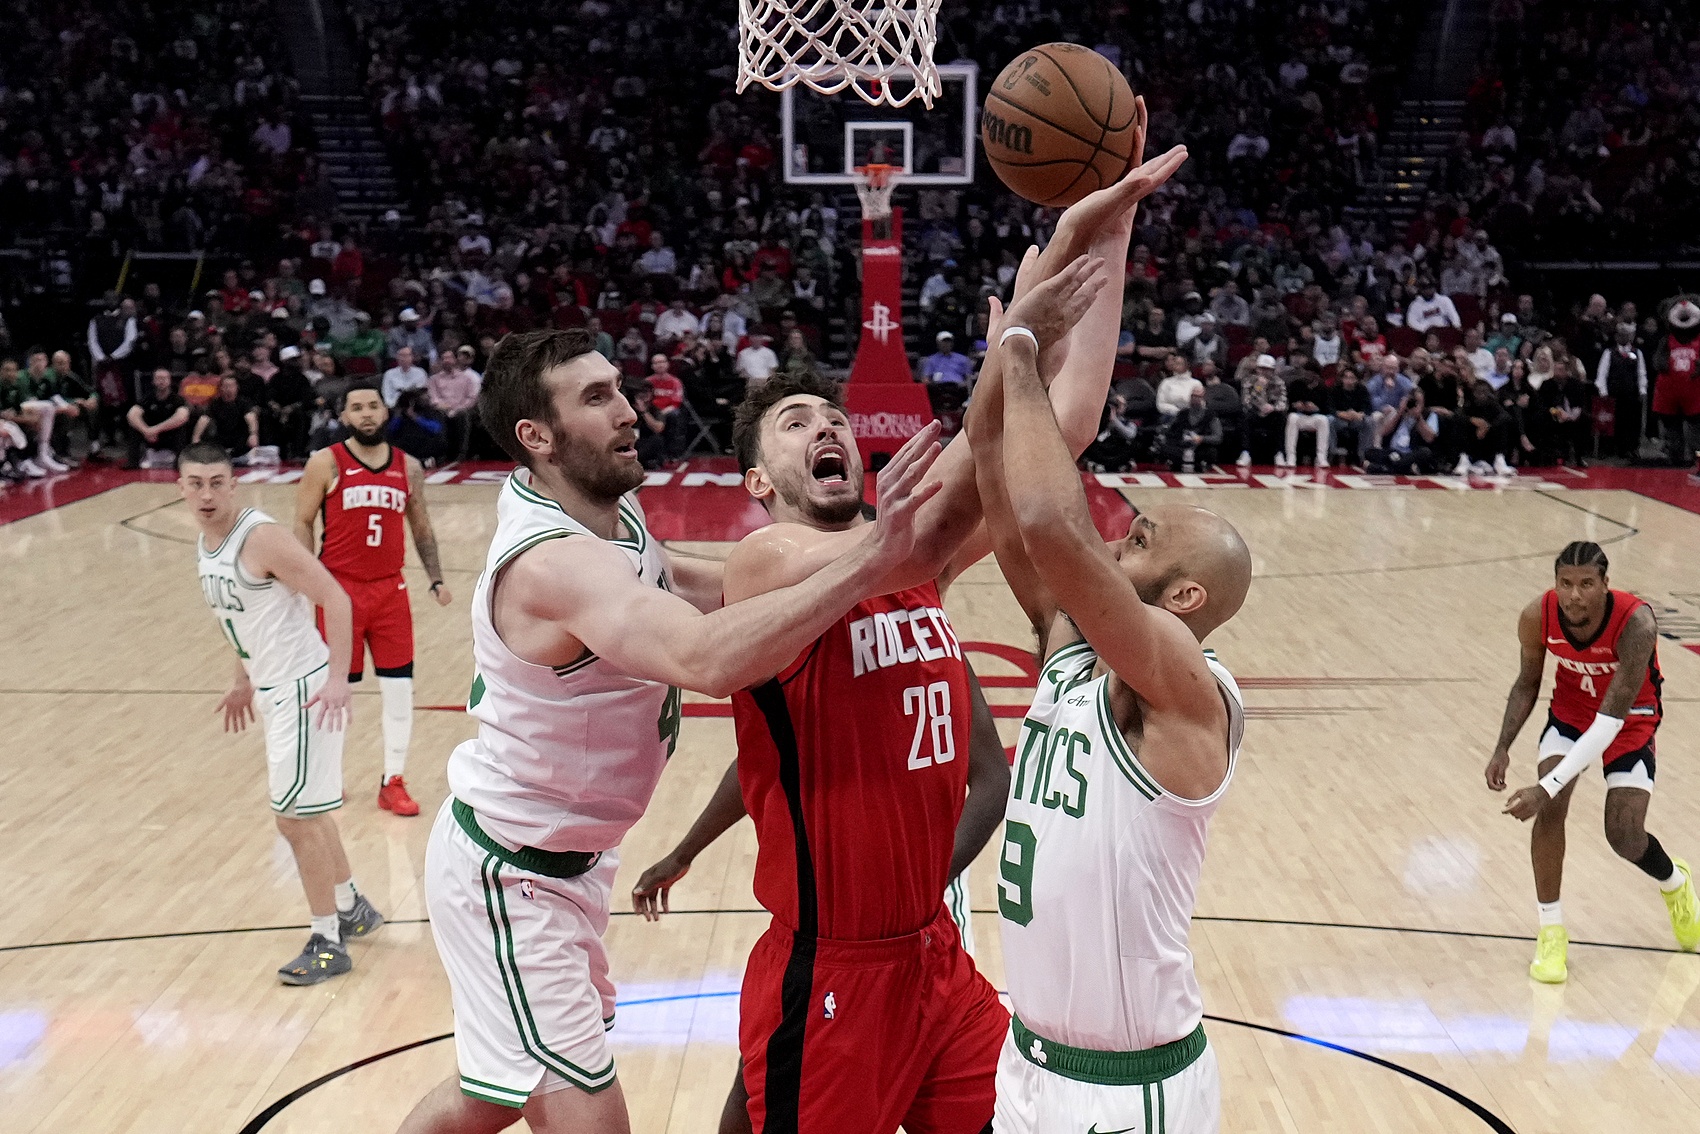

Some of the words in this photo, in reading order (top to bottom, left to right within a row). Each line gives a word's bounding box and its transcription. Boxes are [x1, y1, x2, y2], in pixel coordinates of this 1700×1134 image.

[342, 484, 407, 514] ROCKETS
[366, 513, 383, 547] 5
[1580, 674, 1597, 697] 4
[903, 681, 956, 771] 28
[997, 818, 1038, 928] 9
